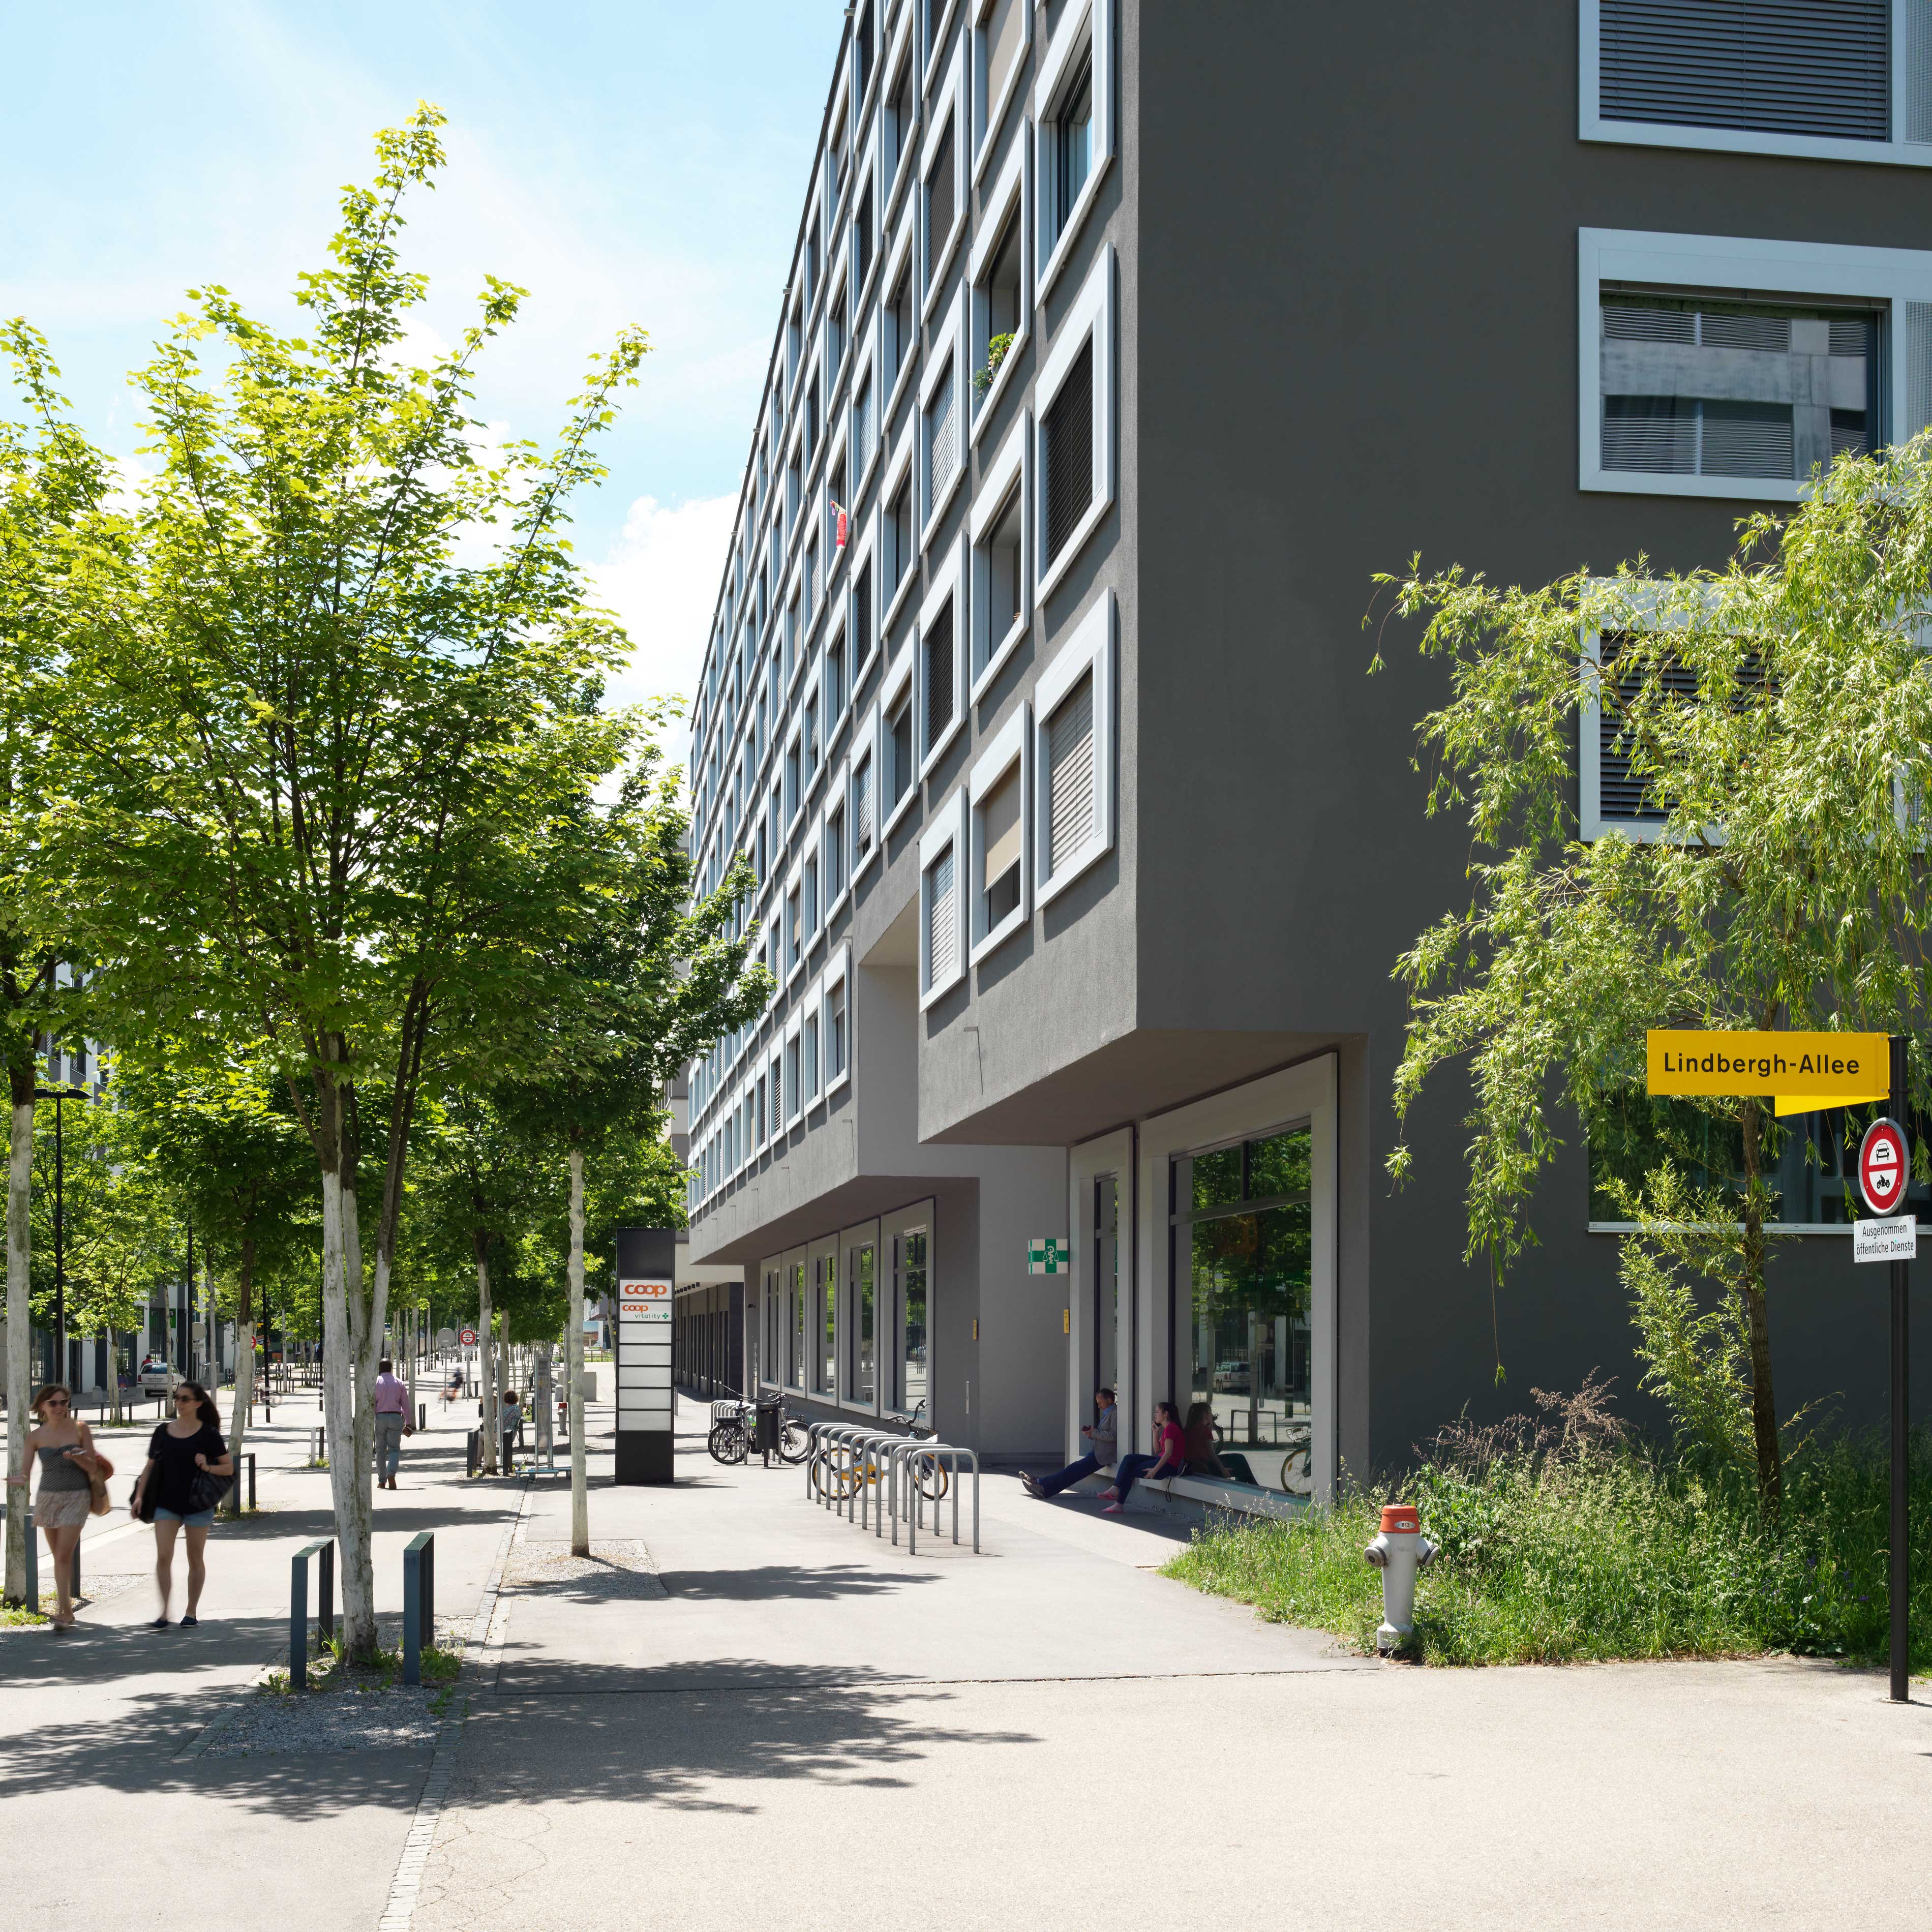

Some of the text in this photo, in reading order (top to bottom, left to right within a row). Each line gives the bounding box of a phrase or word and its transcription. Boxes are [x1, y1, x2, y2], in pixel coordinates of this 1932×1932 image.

[1664, 1052, 1860, 1077] Lindbergh-Allee
[1862, 1224, 1907, 1239] Ausgenommen
[1856, 1241, 1914, 1255] öffentliche Dienste
[624, 1284, 667, 1298] coop
[622, 1305, 649, 1313] coop
